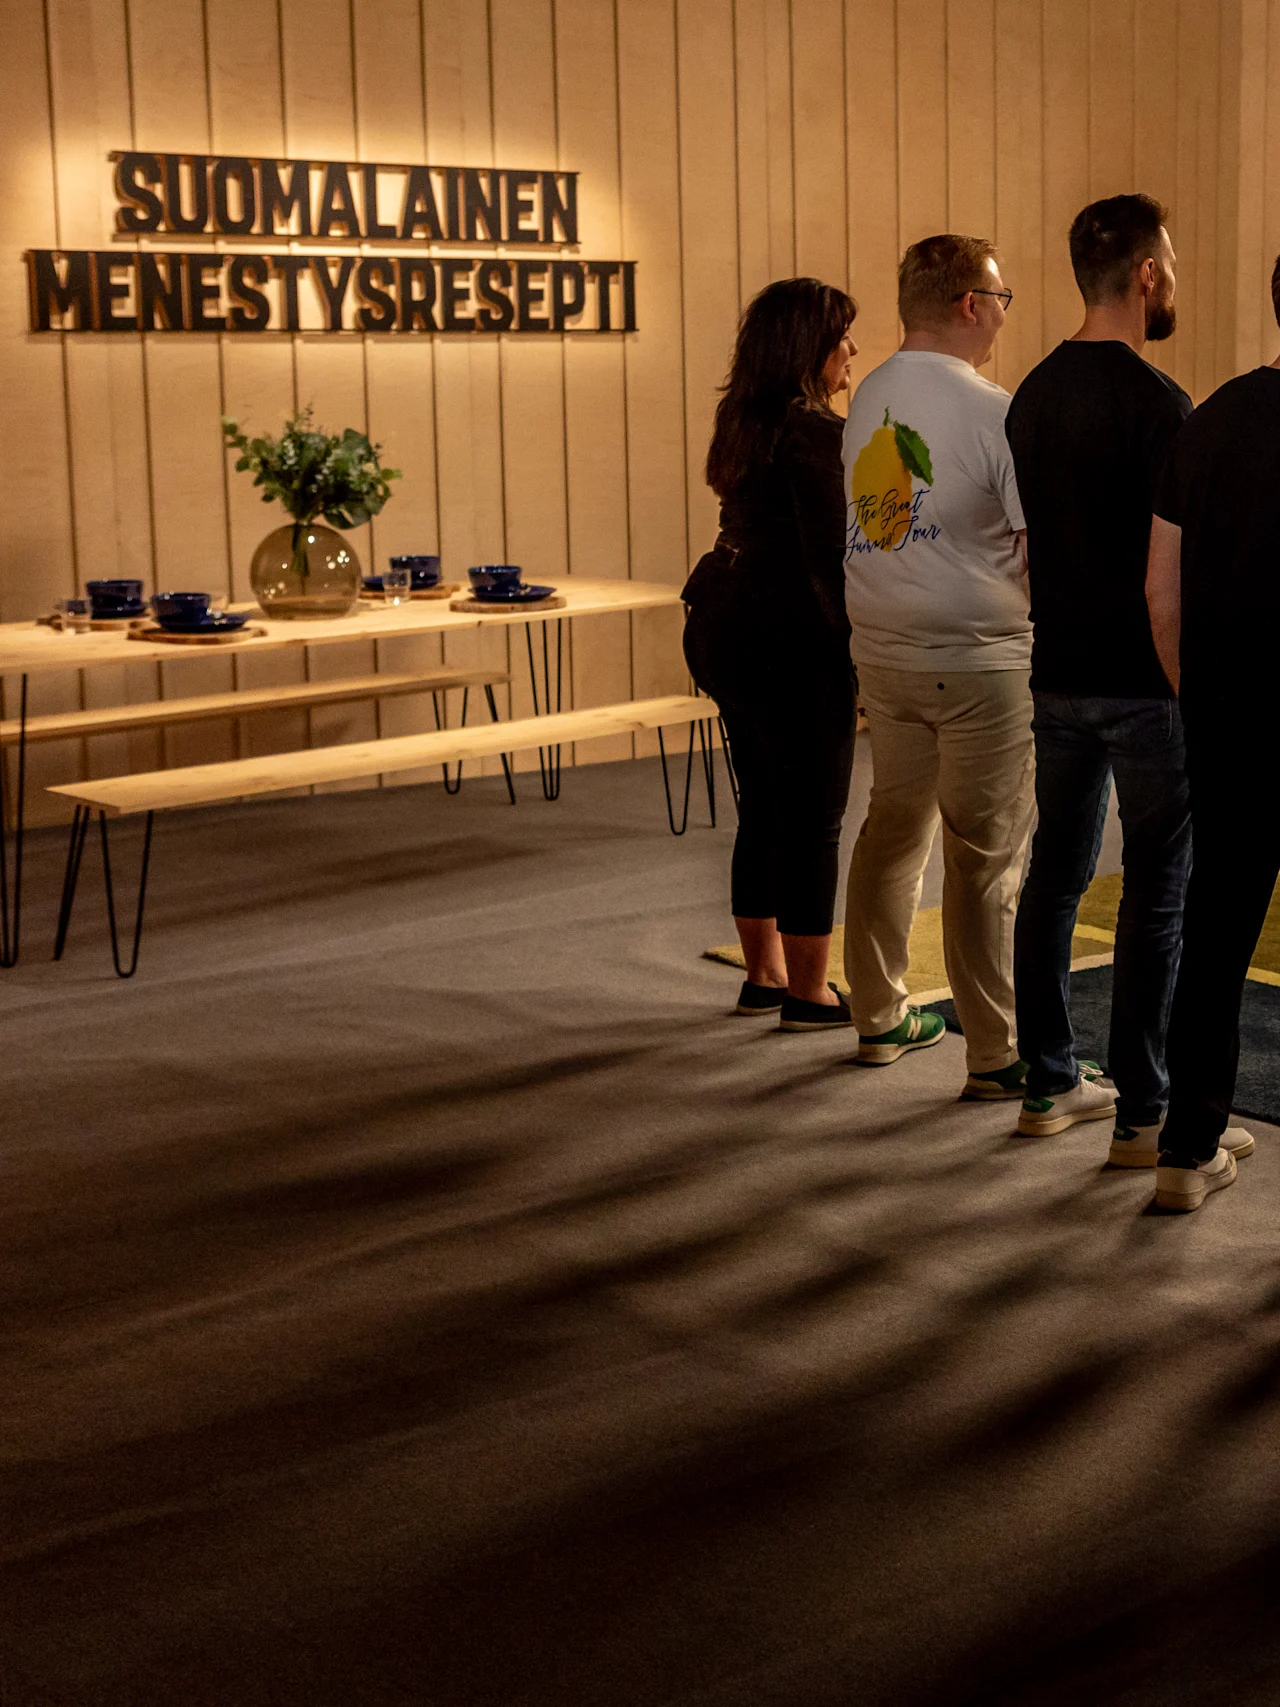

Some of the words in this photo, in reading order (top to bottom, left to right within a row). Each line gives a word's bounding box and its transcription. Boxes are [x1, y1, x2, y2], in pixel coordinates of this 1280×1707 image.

[114, 152, 578, 243] SUOMALAINEN
[29, 250, 637, 331] MENESTYSRESEPTI
[847, 494, 878, 532] The
[880, 488, 931, 531] Great
[892, 515, 942, 552] Tour
